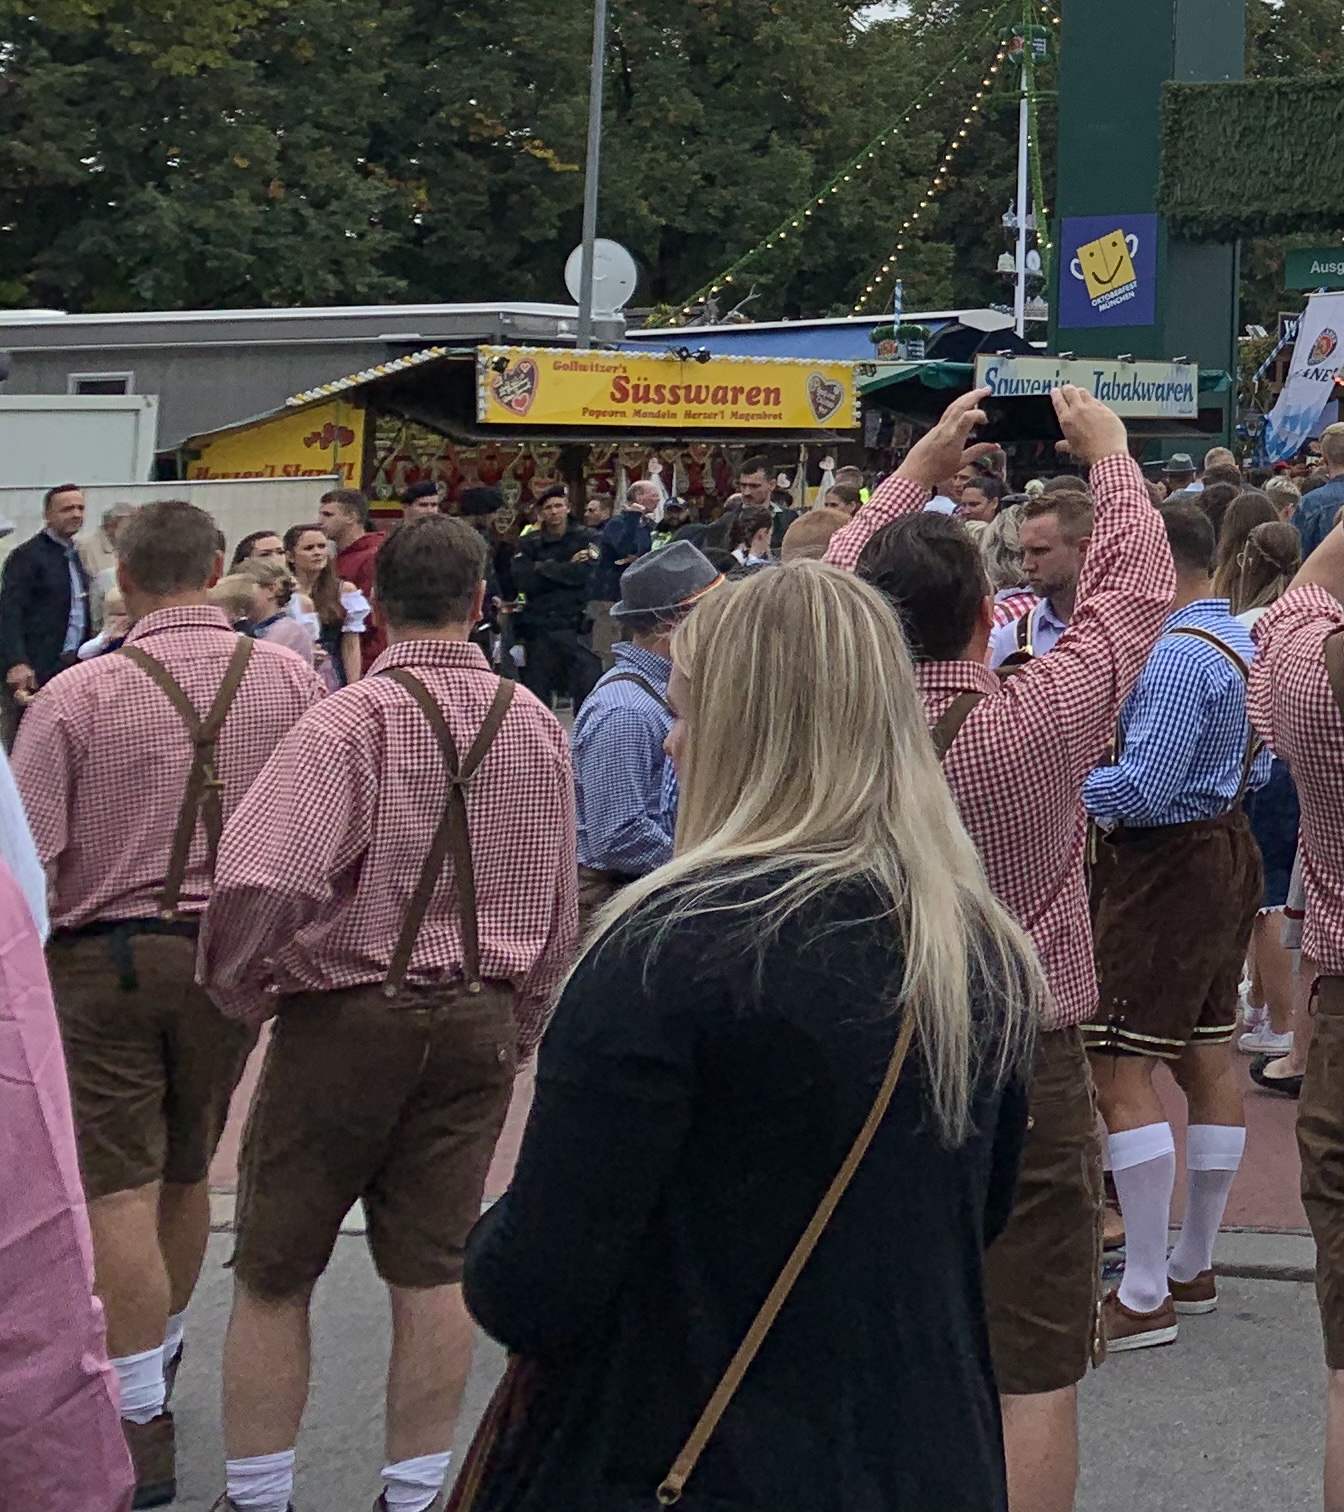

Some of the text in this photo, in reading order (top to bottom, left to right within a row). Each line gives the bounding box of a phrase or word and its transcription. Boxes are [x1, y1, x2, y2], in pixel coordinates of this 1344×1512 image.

[1091, 280, 1138, 306] OKTOBERFEST
[553, 360, 628, 375] Gollwitzer's
[610, 375, 782, 407] Süsswaren
[1093, 370, 1194, 403] Tabakwaren
[582, 407, 627, 420] Popcorn
[632, 409, 678, 420] Mandeln
[730, 411, 783, 422] Magenbrot
